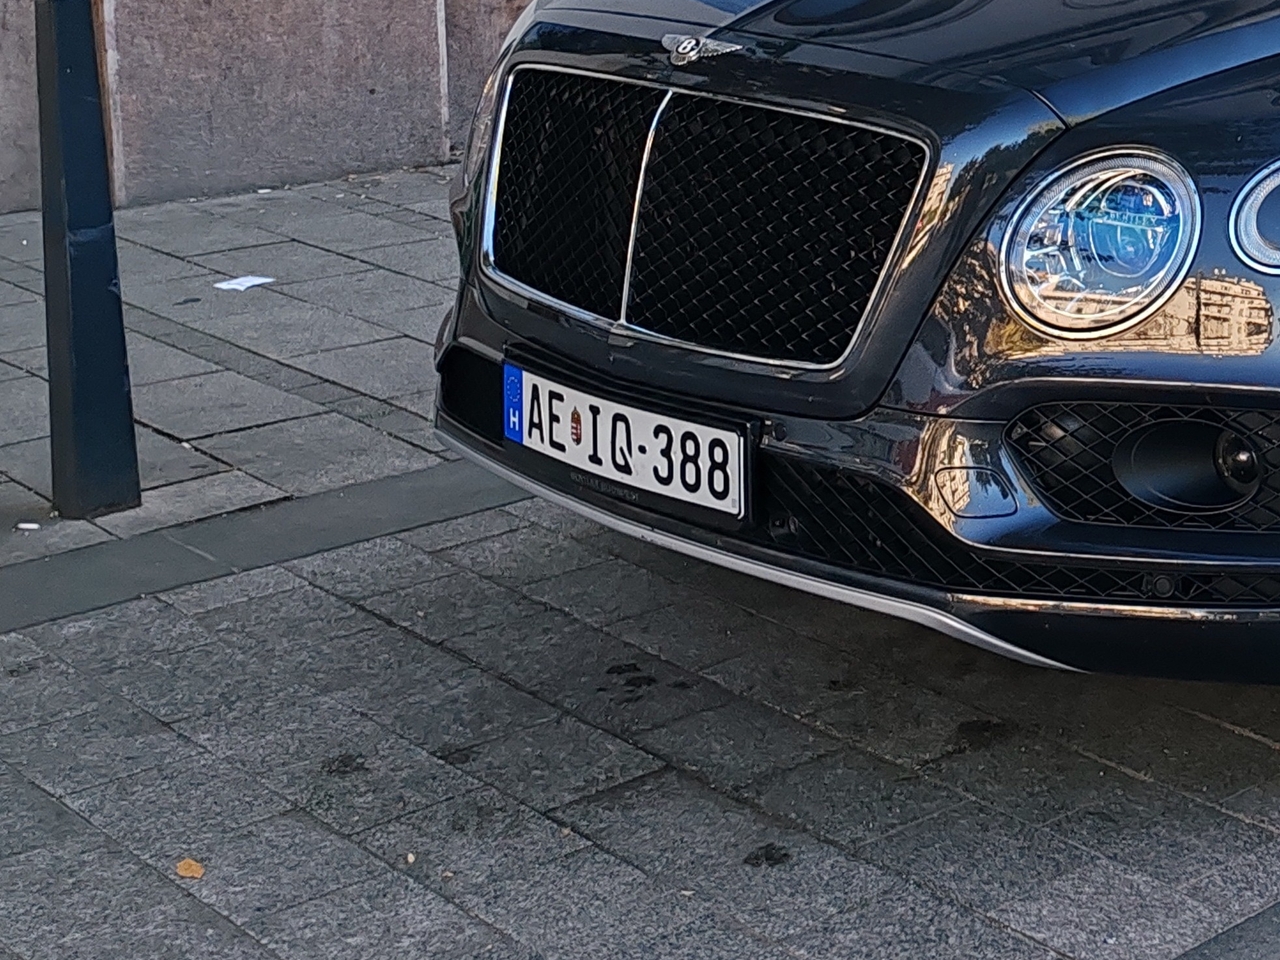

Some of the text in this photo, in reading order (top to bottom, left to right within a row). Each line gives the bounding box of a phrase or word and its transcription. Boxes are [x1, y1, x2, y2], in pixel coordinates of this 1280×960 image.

[509, 383, 730, 500] H AE IQ-388
